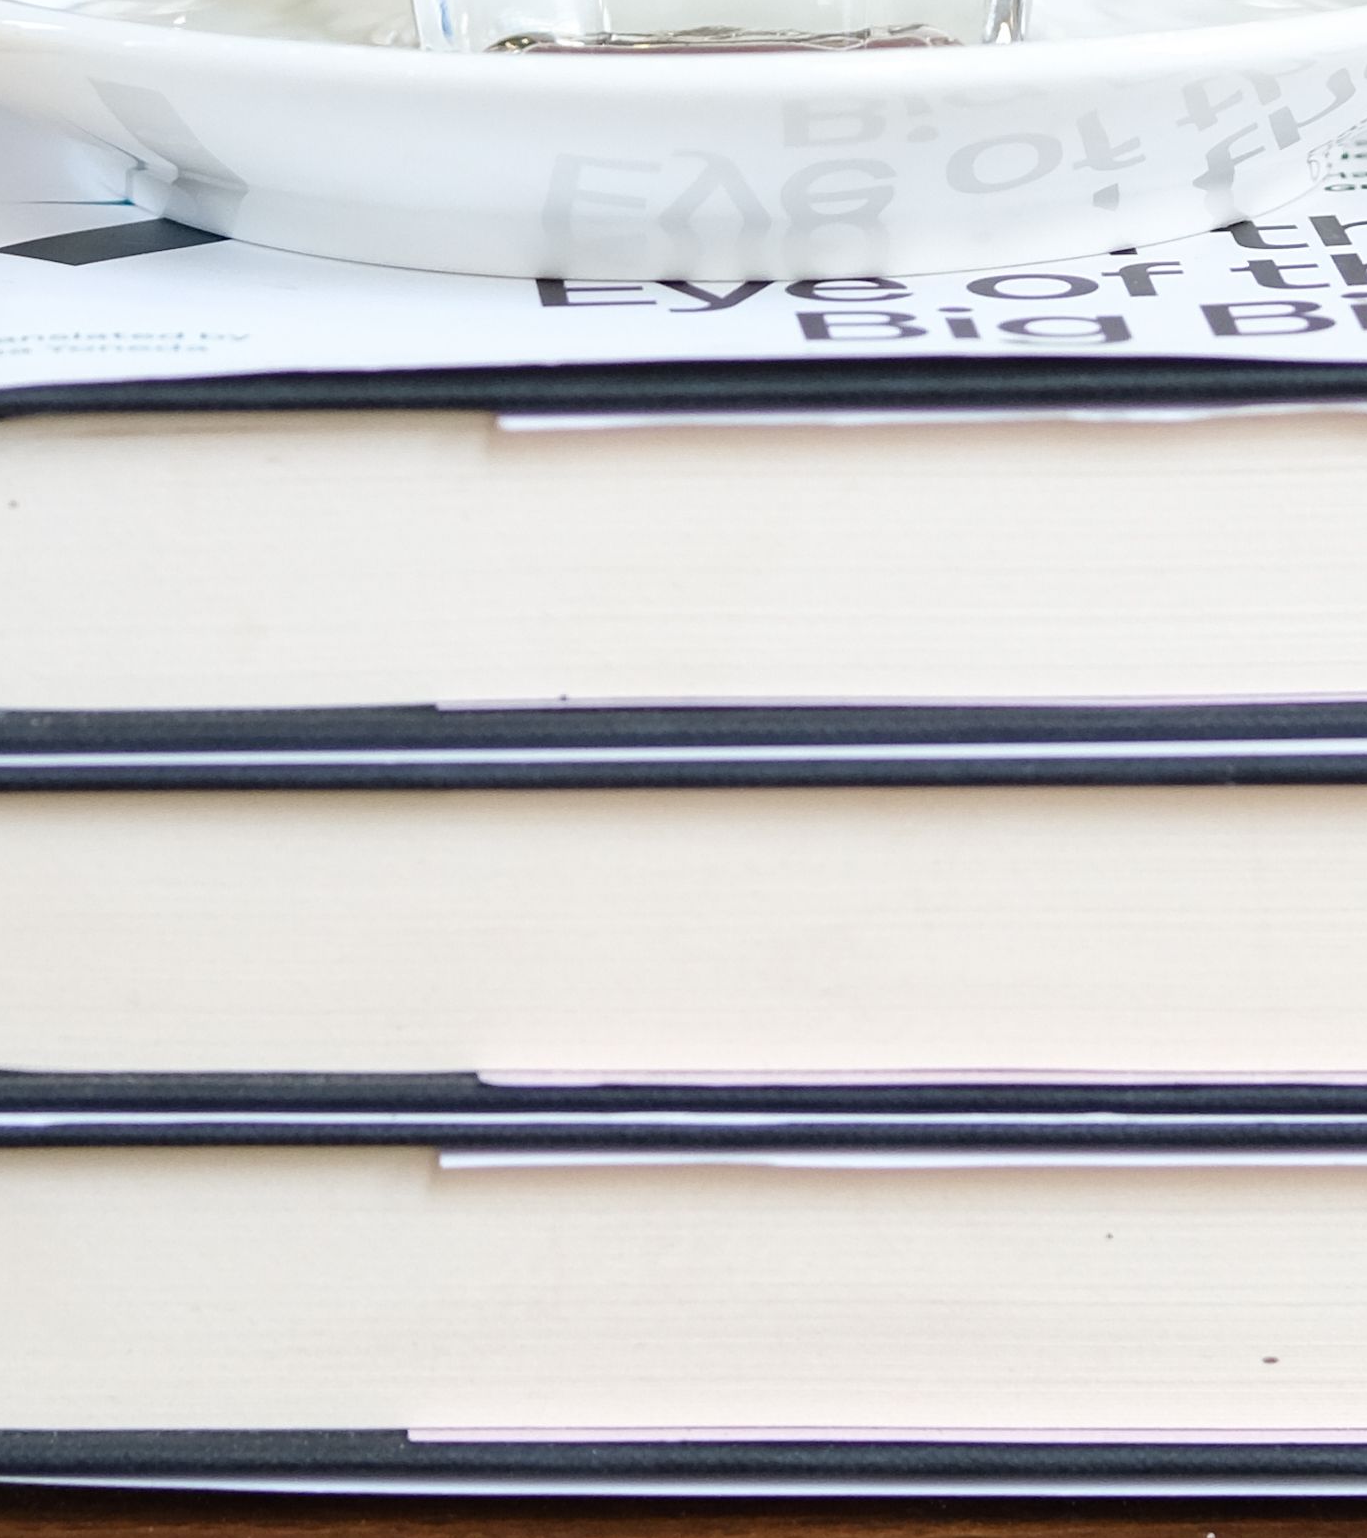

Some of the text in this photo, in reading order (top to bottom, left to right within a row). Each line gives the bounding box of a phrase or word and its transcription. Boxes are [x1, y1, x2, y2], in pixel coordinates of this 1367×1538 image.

[536, 277, 914, 312] Eye
[966, 261, 1183, 299] of
[199, 330, 250, 342] by
[796, 307, 1132, 344] Big
